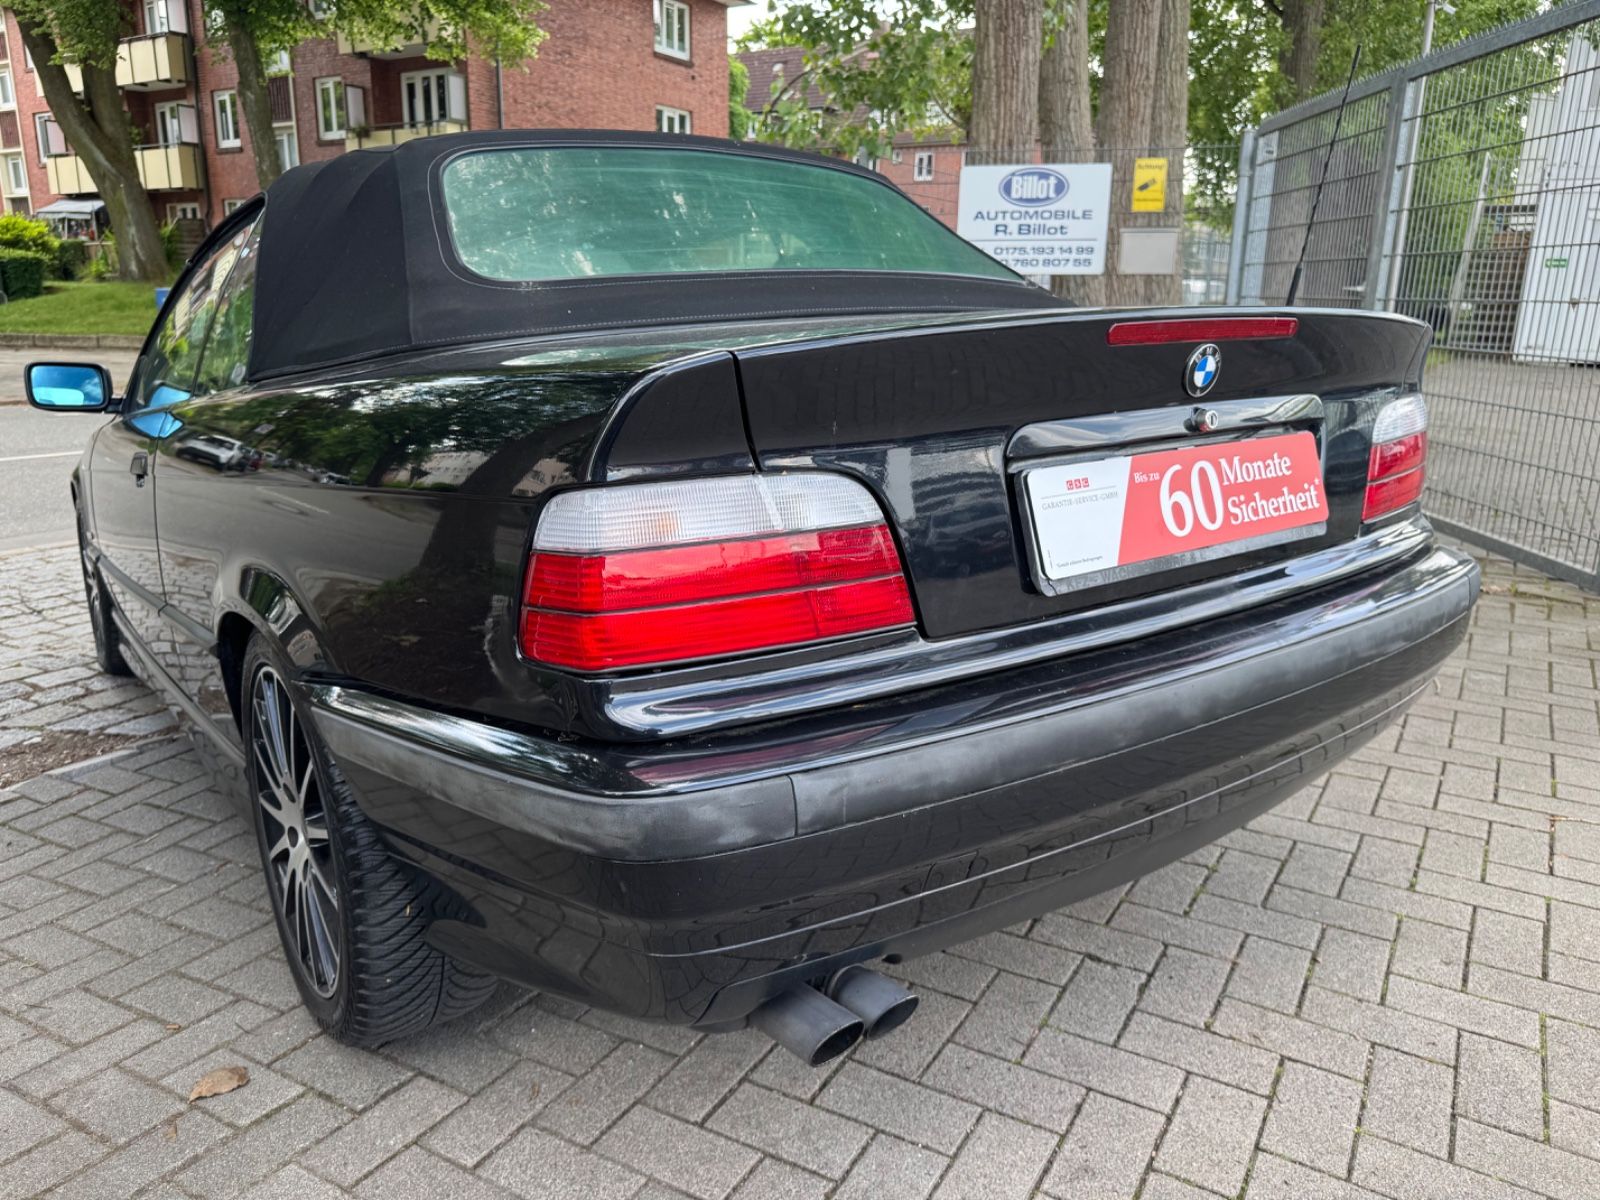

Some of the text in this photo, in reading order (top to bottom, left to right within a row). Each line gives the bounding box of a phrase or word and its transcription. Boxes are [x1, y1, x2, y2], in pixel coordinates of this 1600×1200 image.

[1011, 175, 1058, 199] Billot
[973, 210, 1093, 221] AUTOMOBILE
[994, 223, 1068, 236] R. Billot
[1058, 246, 1073, 255] 14
[1075, 246, 1095, 256] 99
[1041, 258, 1070, 268] 807
[1072, 258, 1092, 267] 55
[1194, 346, 1221, 364] BMW
[1219, 452, 1292, 486] Monate
[1133, 471, 1160, 484] Bis zu
[1159, 460, 1224, 537] 60
